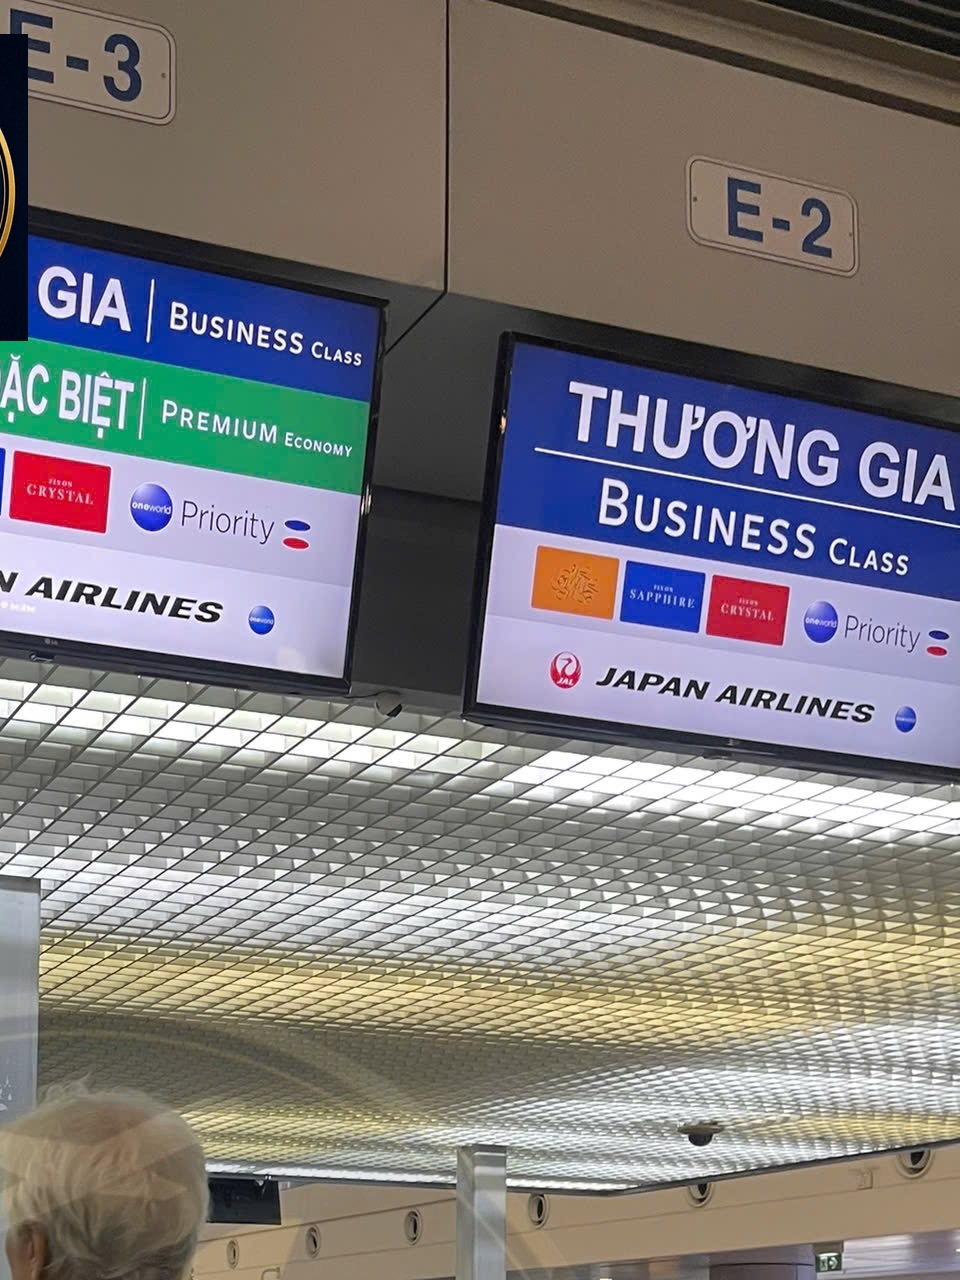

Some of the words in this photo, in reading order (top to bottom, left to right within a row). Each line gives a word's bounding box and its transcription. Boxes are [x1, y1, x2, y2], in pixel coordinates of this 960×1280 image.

[10, 8, 142, 102] E-3
[727, 177, 832, 258] E-2
[38, 265, 131, 332] GIA
[58, 370, 135, 439] BIỆT
[568, 380, 840, 486] THƯƠNG
[858, 441, 956, 511] GIA
[26, 483, 94, 505] CRYSTAL
[132, 500, 171, 515] oneworld
[181, 500, 275, 544] Priority
[25, 575, 224, 623] AIRLINES
[629, 588, 695, 609] SAPPHIRE
[720, 603, 775, 621] CRYSTAL
[844, 615, 921, 653] Priority
[595, 667, 710, 700] JAPAN
[715, 684, 876, 723] AIRLINES
